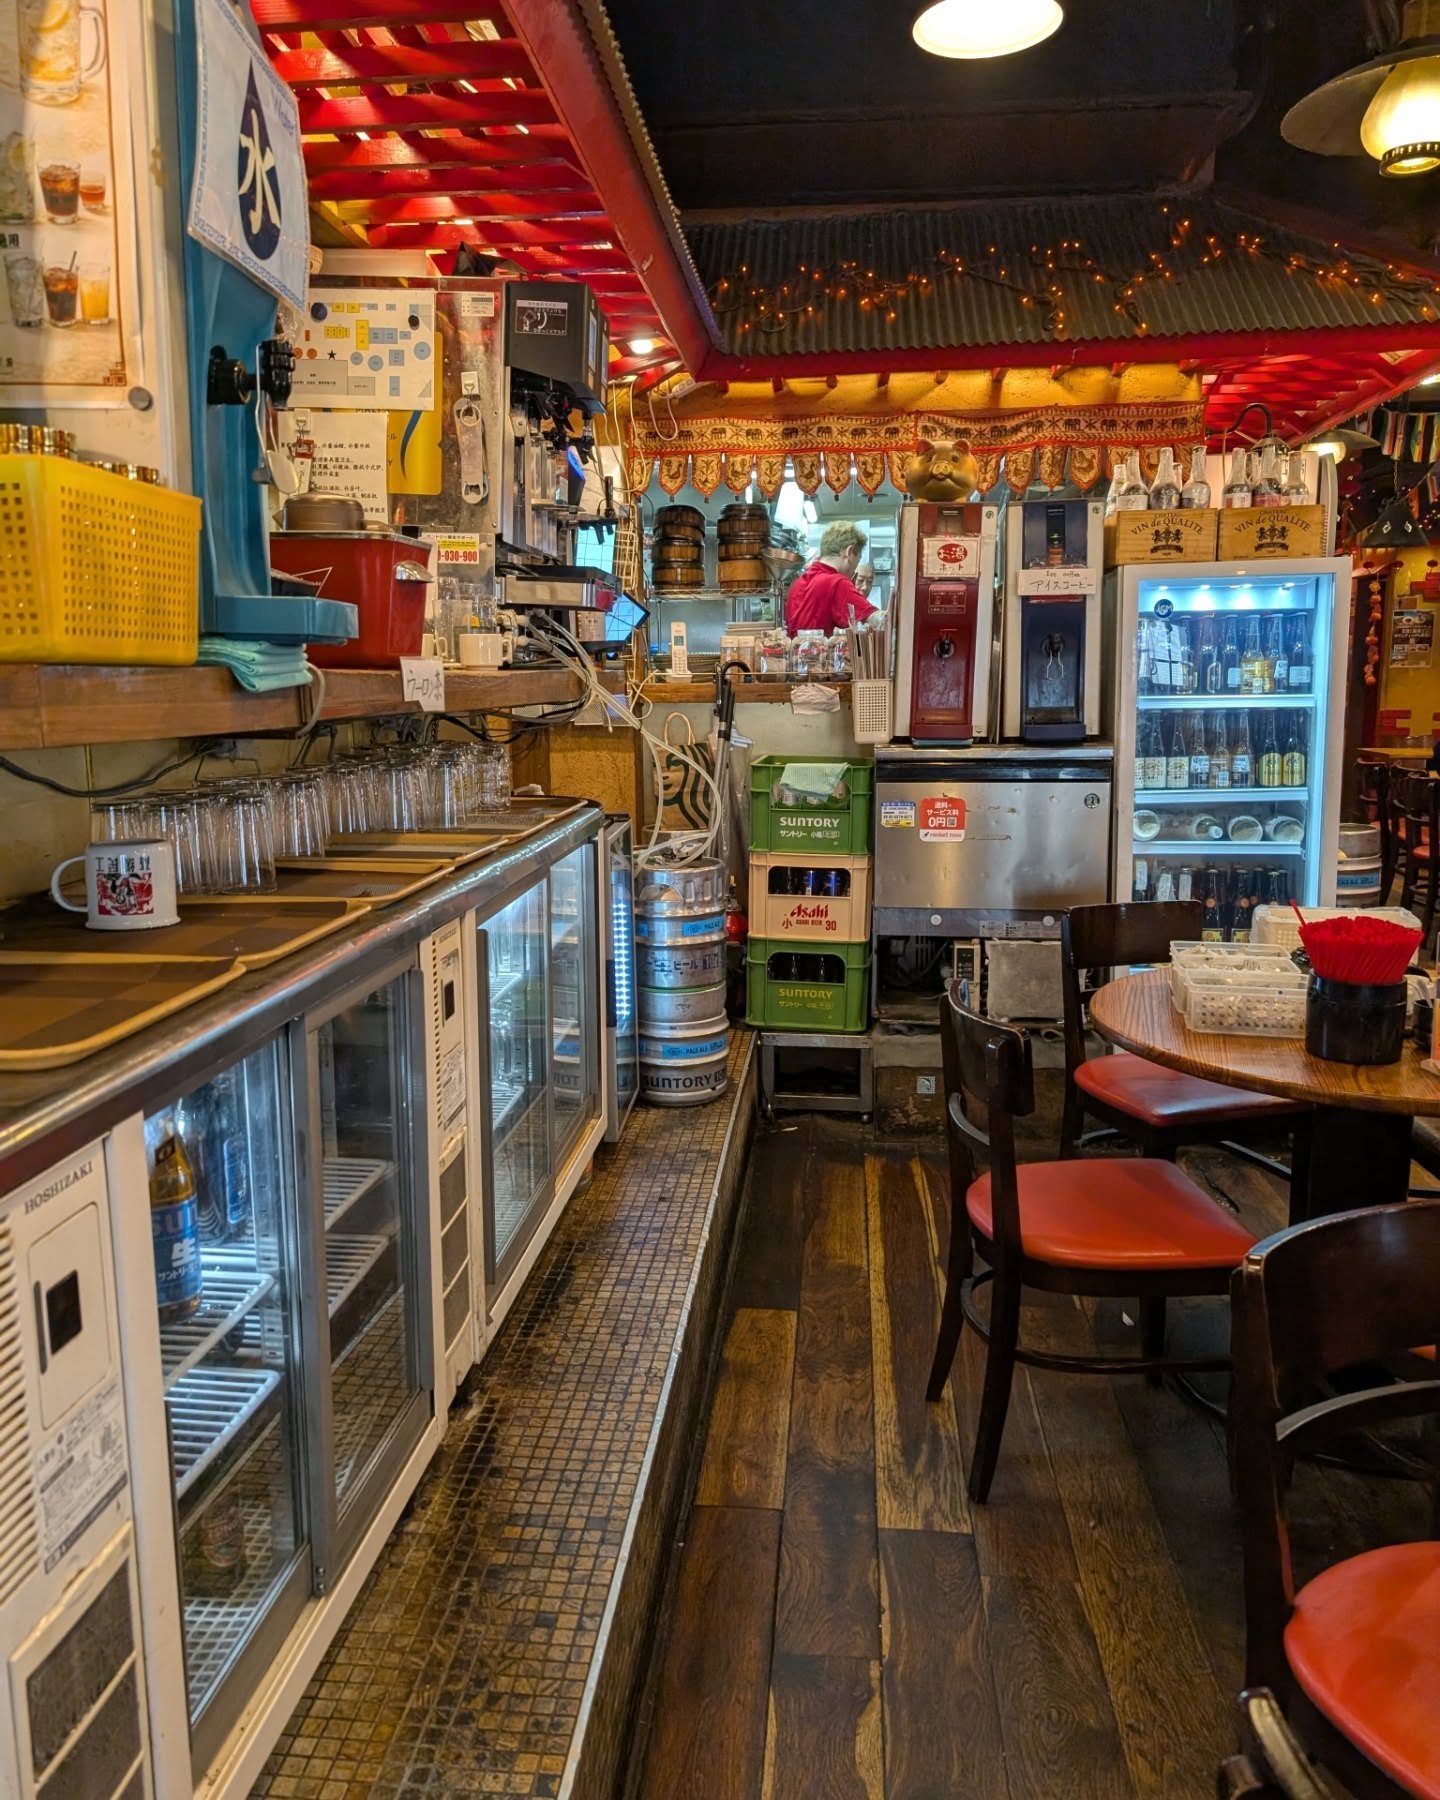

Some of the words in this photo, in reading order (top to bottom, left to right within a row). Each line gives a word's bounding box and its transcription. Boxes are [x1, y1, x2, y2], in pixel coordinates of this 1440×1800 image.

[1131, 522, 1149, 535] VIN
[1151, 517, 1161, 527] de
[1235, 520, 1254, 533] VIN
[1256, 516, 1266, 525] de
[938, 546, 966, 561] お湯
[1029, 579, 1094, 593] アイスコーヒー
[926, 809, 960, 817] サービス料
[780, 817, 840, 828] SUNTORY
[928, 817, 946, 828] 0円
[780, 830, 807, 838] サントリー
[790, 903, 829, 919] Asahi
[782, 918, 793, 929] 小
[825, 920, 837, 931] 30
[779, 988, 833, 999] SUNTORY
[25, 1161, 92, 1215] HOSHIZAKI
[171, 1238, 196, 1268] 生
